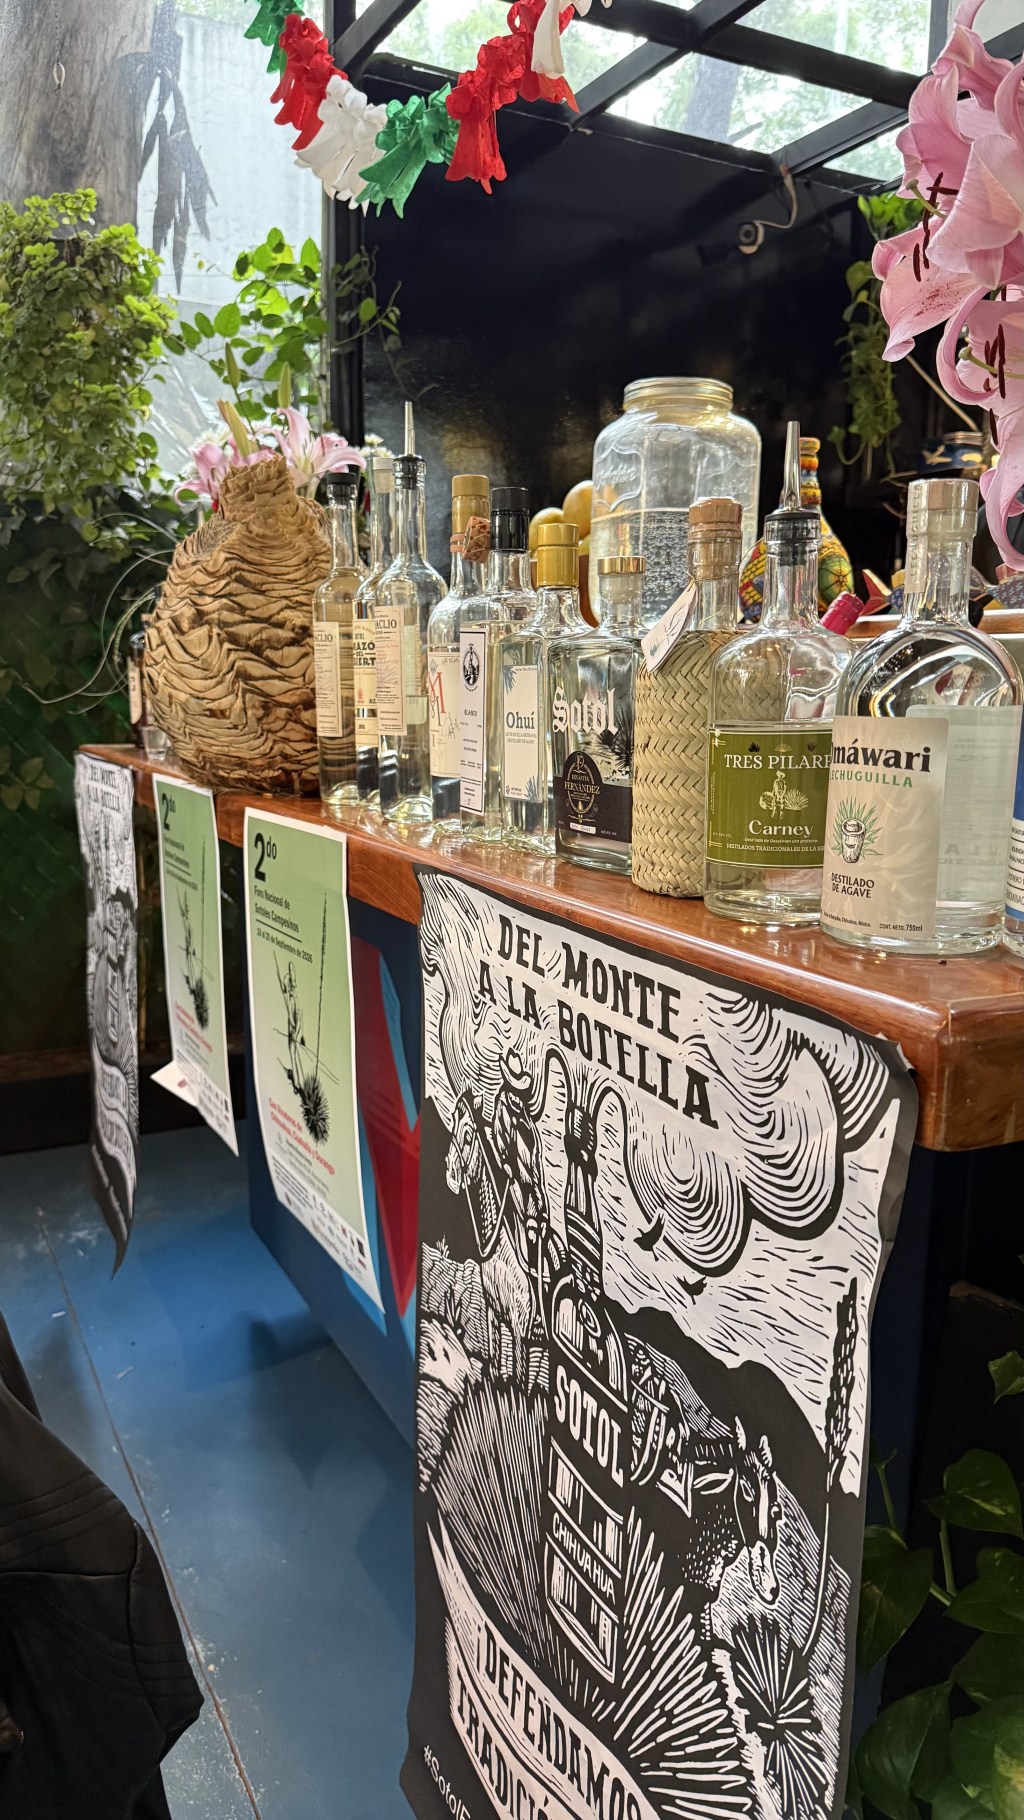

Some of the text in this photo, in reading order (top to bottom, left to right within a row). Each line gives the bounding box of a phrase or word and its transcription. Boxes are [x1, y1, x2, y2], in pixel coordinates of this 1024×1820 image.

[463, 709, 478, 717] BLANCO
[506, 711, 535, 729] Ohuí
[553, 685, 619, 735] Sotol
[724, 754, 763, 769] TRES
[831, 738, 931, 773] máwari
[564, 781, 600, 795] FERNÁNDEZ
[748, 819, 814, 838] Carney
[726, 842, 756, 850] DESTILADOS
[254, 832, 277, 882] 2do
[831, 872, 875, 889] DESTILADO
[832, 883, 872, 898] DE AGAVE
[254, 885, 291, 911] Foro Nacional de
[271, 910, 299, 933] Campesinos
[906, 924, 923, 932] 750ml
[498, 914, 682, 1043] DEL MONTE
[477, 960, 720, 1130] A LA BOTELLA
[554, 1364, 624, 1489] SOTOL
[552, 1512, 616, 1605] CHIHUAHUA
